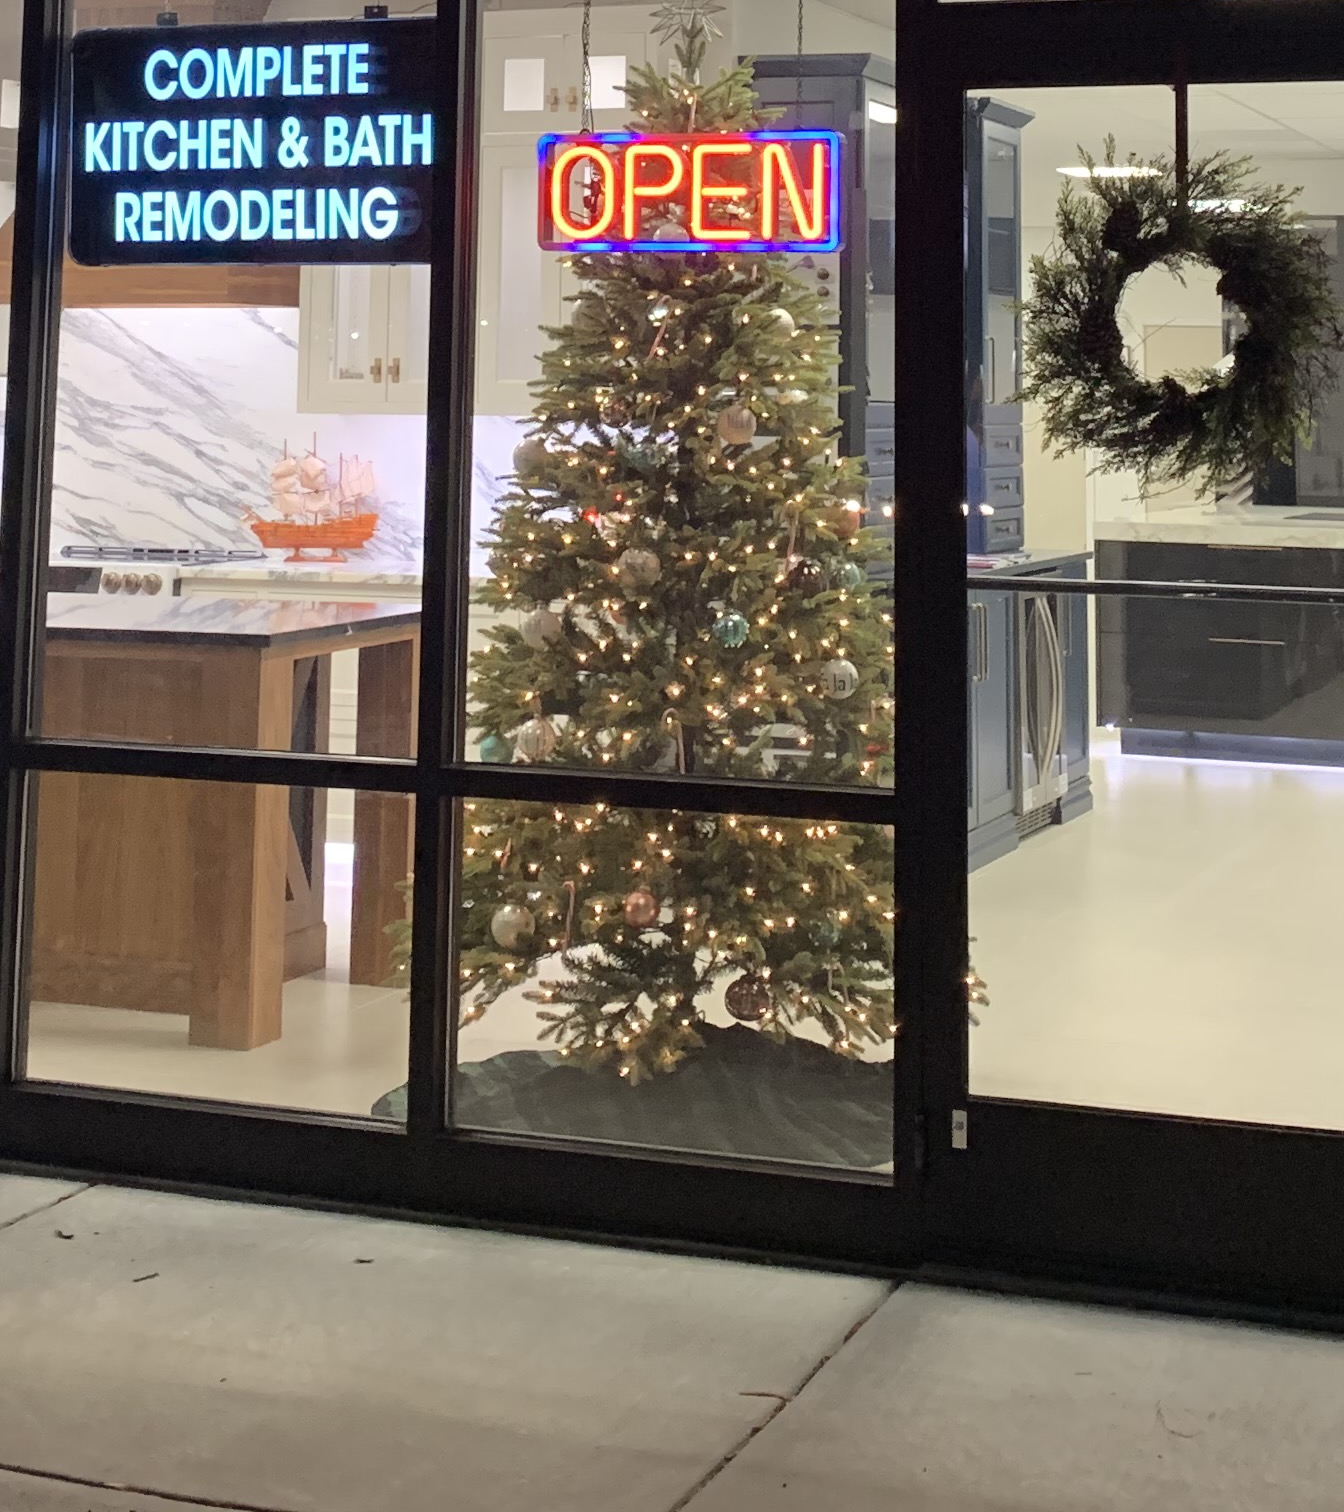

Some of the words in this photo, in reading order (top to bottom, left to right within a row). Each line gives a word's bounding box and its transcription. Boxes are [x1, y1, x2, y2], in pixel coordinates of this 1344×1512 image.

[144, 43, 370, 101] COMPLETE
[84, 117, 263, 173] KITCHEN
[277, 117, 310, 169] &
[323, 113, 432, 168] BATH
[114, 186, 399, 243] REMODELING
[552, 143, 825, 240] OPEN
